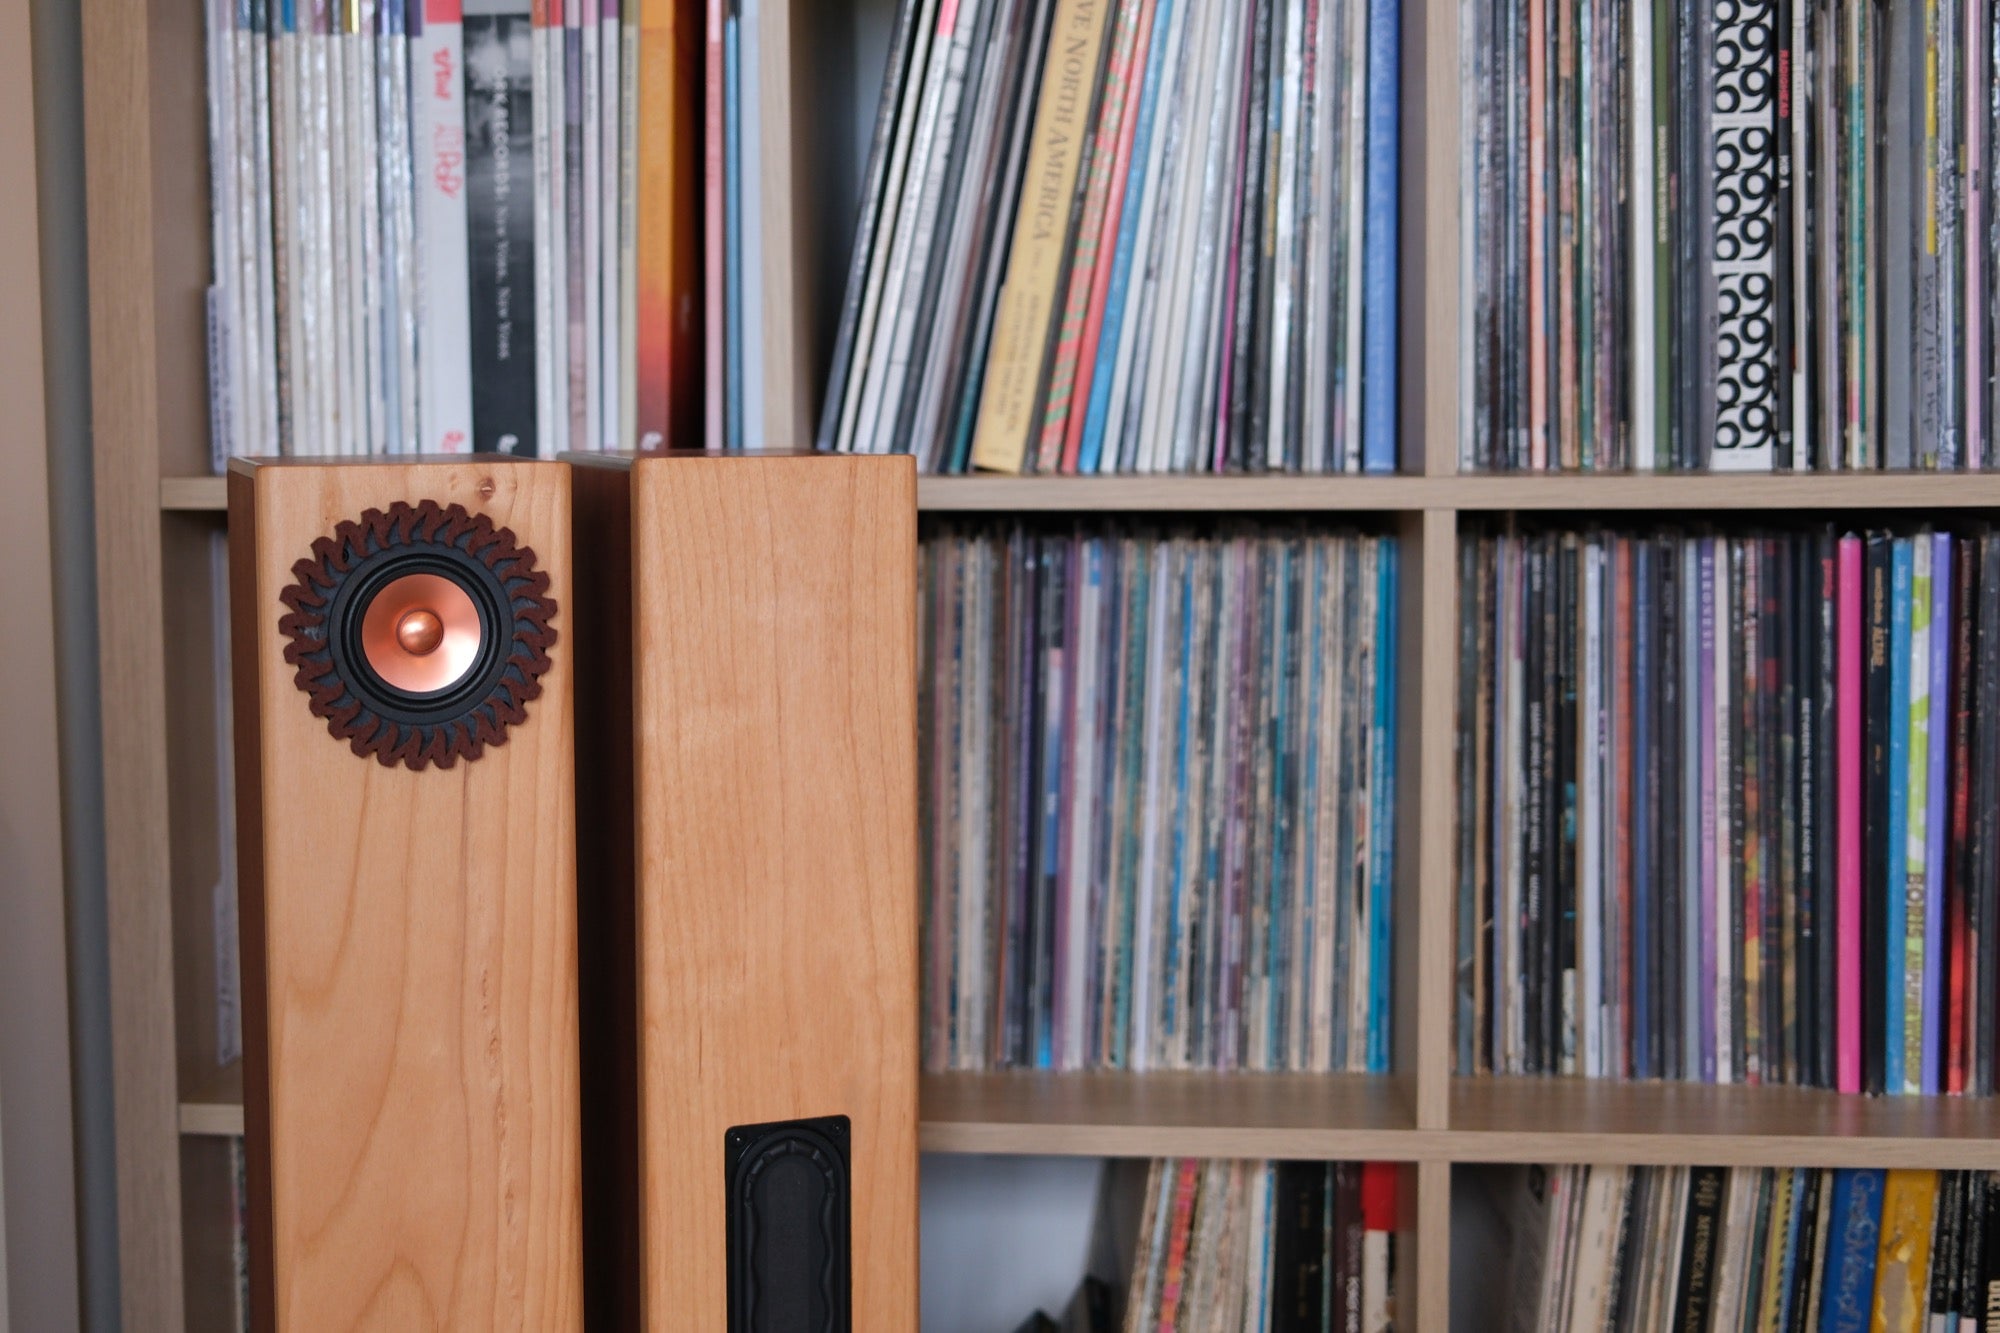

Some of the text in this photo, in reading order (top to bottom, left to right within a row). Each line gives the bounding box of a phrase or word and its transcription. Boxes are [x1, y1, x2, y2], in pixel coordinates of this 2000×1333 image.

[1778, 49, 1790, 118] RADIOHEAD
[1778, 155, 1790, 189] KID A
[1923, 273, 1935, 316] Rap
[1923, 346, 1936, 381] Hip
[1922, 392, 1936, 433] Hop
[1702, 556, 1712, 649] BARONESS
[1690, 1215, 1711, 1291] MUSICAL
